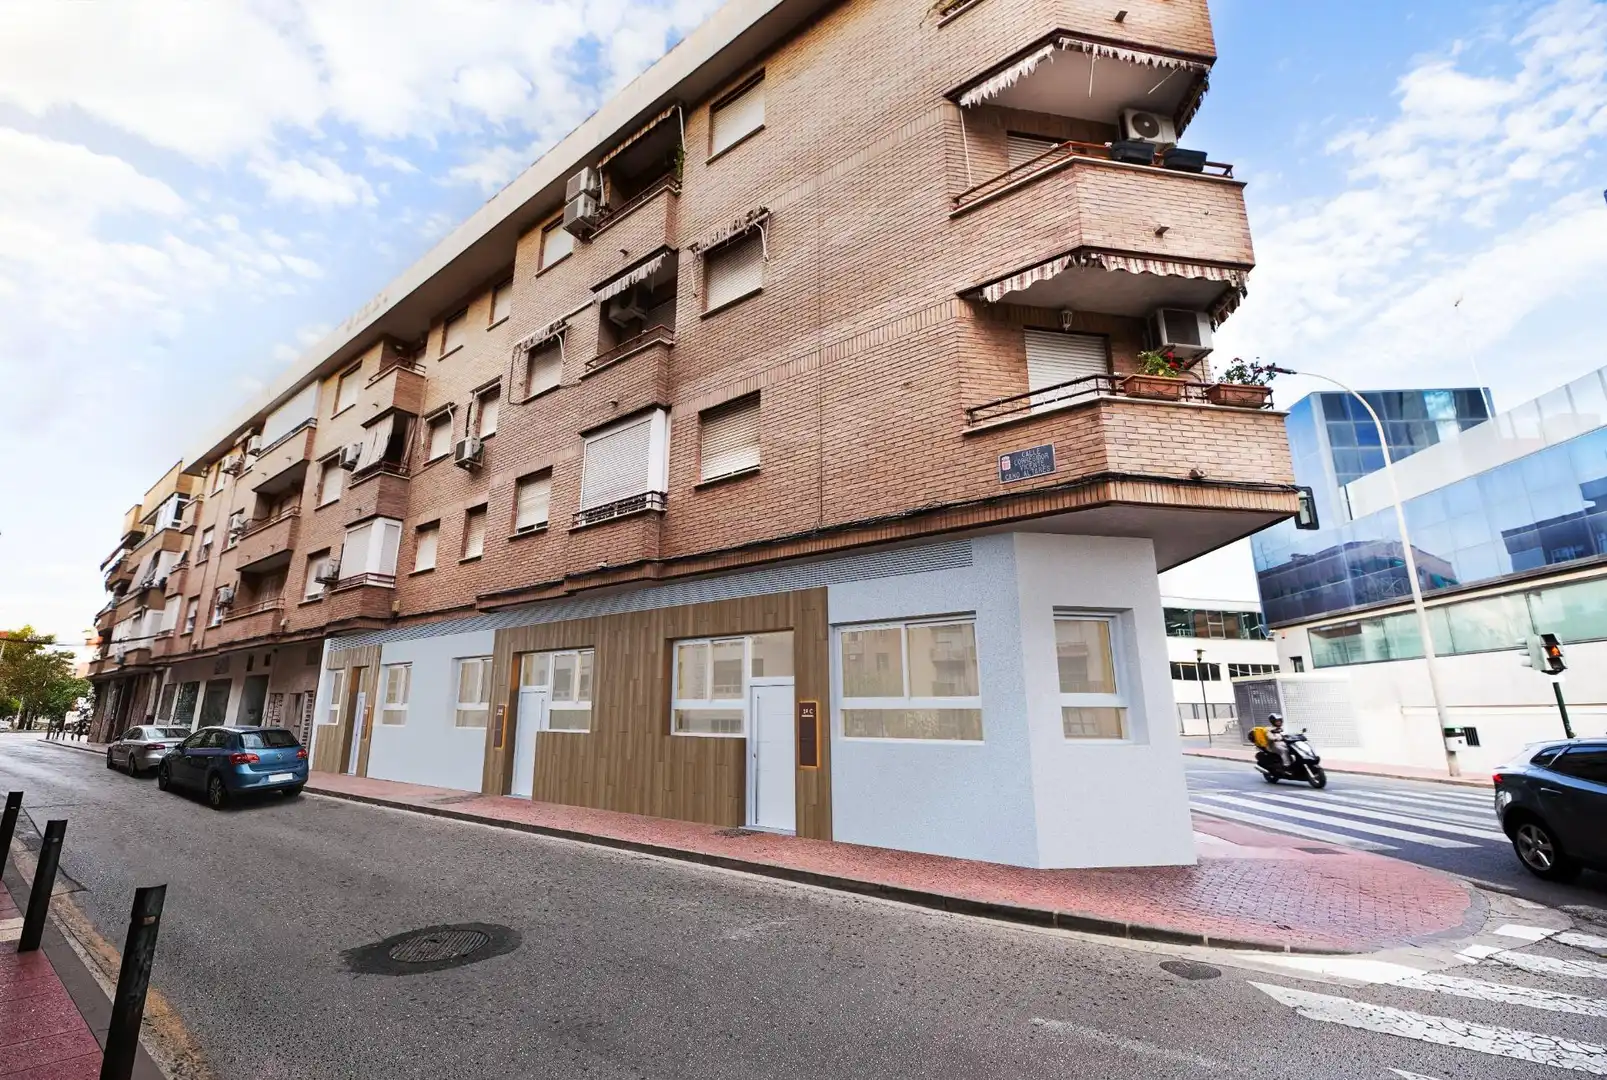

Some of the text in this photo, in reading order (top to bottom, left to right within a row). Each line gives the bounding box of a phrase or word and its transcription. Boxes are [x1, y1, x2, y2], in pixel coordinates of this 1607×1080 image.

[1021, 448, 1041, 458] CALLE
[1020, 460, 1045, 471] VICENTE
[1004, 472, 1020, 481] CANO
